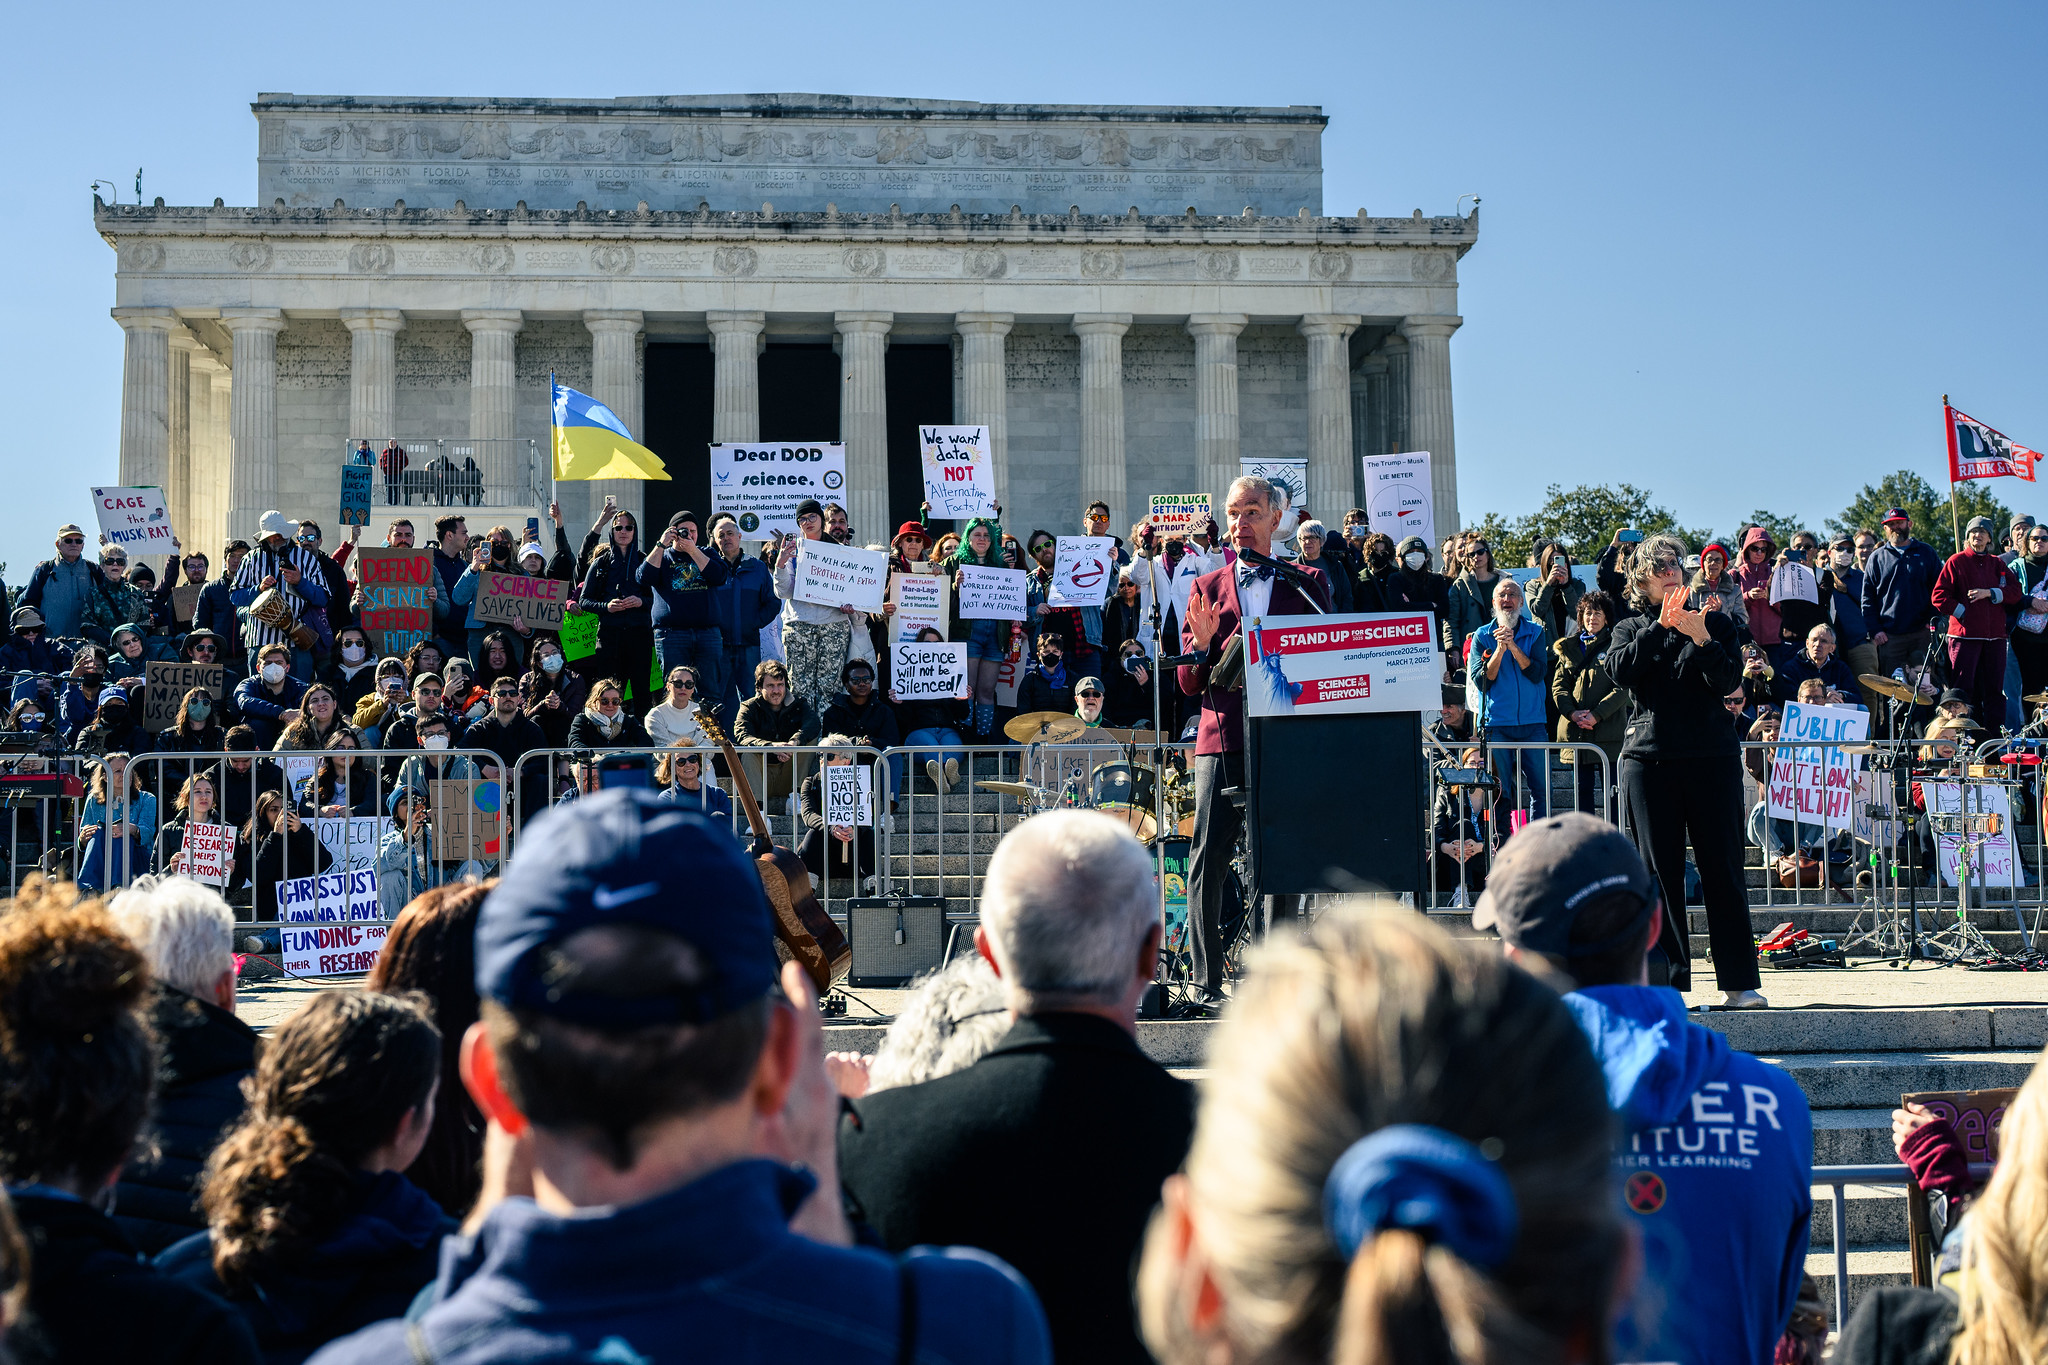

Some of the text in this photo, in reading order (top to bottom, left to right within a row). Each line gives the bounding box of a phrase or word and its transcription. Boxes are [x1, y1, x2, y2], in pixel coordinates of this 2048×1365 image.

[280, 167, 1300, 185] ARKANSAS MICHIGAN FLORIDA TEXAS IOWA WISCONSIN CALIFORNIA MINNESOTA OREGON KANSAS WEST VIRGINIA NEVADA NEBRASKA COLORADO NORTH DAKOTA
[525, 252, 582, 262] GEORGIA
[1247, 258, 1303, 268] VIRGINIA
[923, 428, 980, 445] We want
[734, 448, 823, 462] Dear DOD
[936, 444, 970, 461] data
[1380, 460, 1402, 468] Trump
[1958, 462, 1996, 477] RANK
[346, 470, 371, 480] FIGHT
[742, 472, 815, 486] science.
[944, 466, 974, 482] NOT
[1392, 472, 1414, 480] METER
[104, 496, 146, 510] CAGE
[343, 492, 370, 503] GIRL
[1152, 495, 1208, 505] GOOD LUCK
[749, 504, 782, 512] solidarity
[1152, 504, 1210, 514] GETTING TO
[127, 514, 146, 524] the
[1164, 514, 1191, 522] MARS
[1186, 512, 1212, 534] SCIENCE
[108, 526, 170, 543] (MUSK) RAT
[362, 556, 431, 584] DEFEND
[806, 552, 874, 574] THE NIH GAVE MY
[806, 578, 819, 586] YEAR
[810, 565, 876, 586] BROTHER A EXTRA
[488, 574, 560, 600] SCIENCE
[902, 586, 938, 594] Mar-a-Lago
[962, 582, 994, 590] WORRIED
[363, 586, 430, 611] SCIENCE
[481, 596, 524, 618] SAVES
[526, 600, 565, 623] LIVES
[962, 601, 1026, 614] NOT MY FUTURE!
[361, 609, 429, 631] DEFEND
[1280, 632, 1328, 648] STAND
[1330, 630, 1350, 643] UP
[1364, 624, 1424, 640] SCIENCE
[897, 646, 958, 666] Science
[1344, 646, 1430, 661] standupforscience2025.org
[1386, 656, 1430, 667] MARCH 7, 2025
[150, 666, 223, 688] SCIENCE
[896, 665, 950, 678] will not be
[896, 674, 964, 696] Silenced!
[1318, 678, 1357, 690] SCIENCE
[1384, 676, 1396, 684] and
[1319, 688, 1368, 700] EVERYONE
[146, 702, 162, 720] US
[1784, 704, 1856, 740] PUBLIC
[1774, 762, 1808, 784] NOT
[831, 781, 862, 792] DATA
[831, 792, 863, 806] NOT
[1770, 784, 1850, 818] WEALTH!
[194, 852, 216, 861] HELPS
[331, 870, 377, 896] JUST
[282, 926, 386, 952] FUNDING FOR
[284, 960, 310, 971] THEIR
[1658, 1155, 1752, 1170] LEARNING
